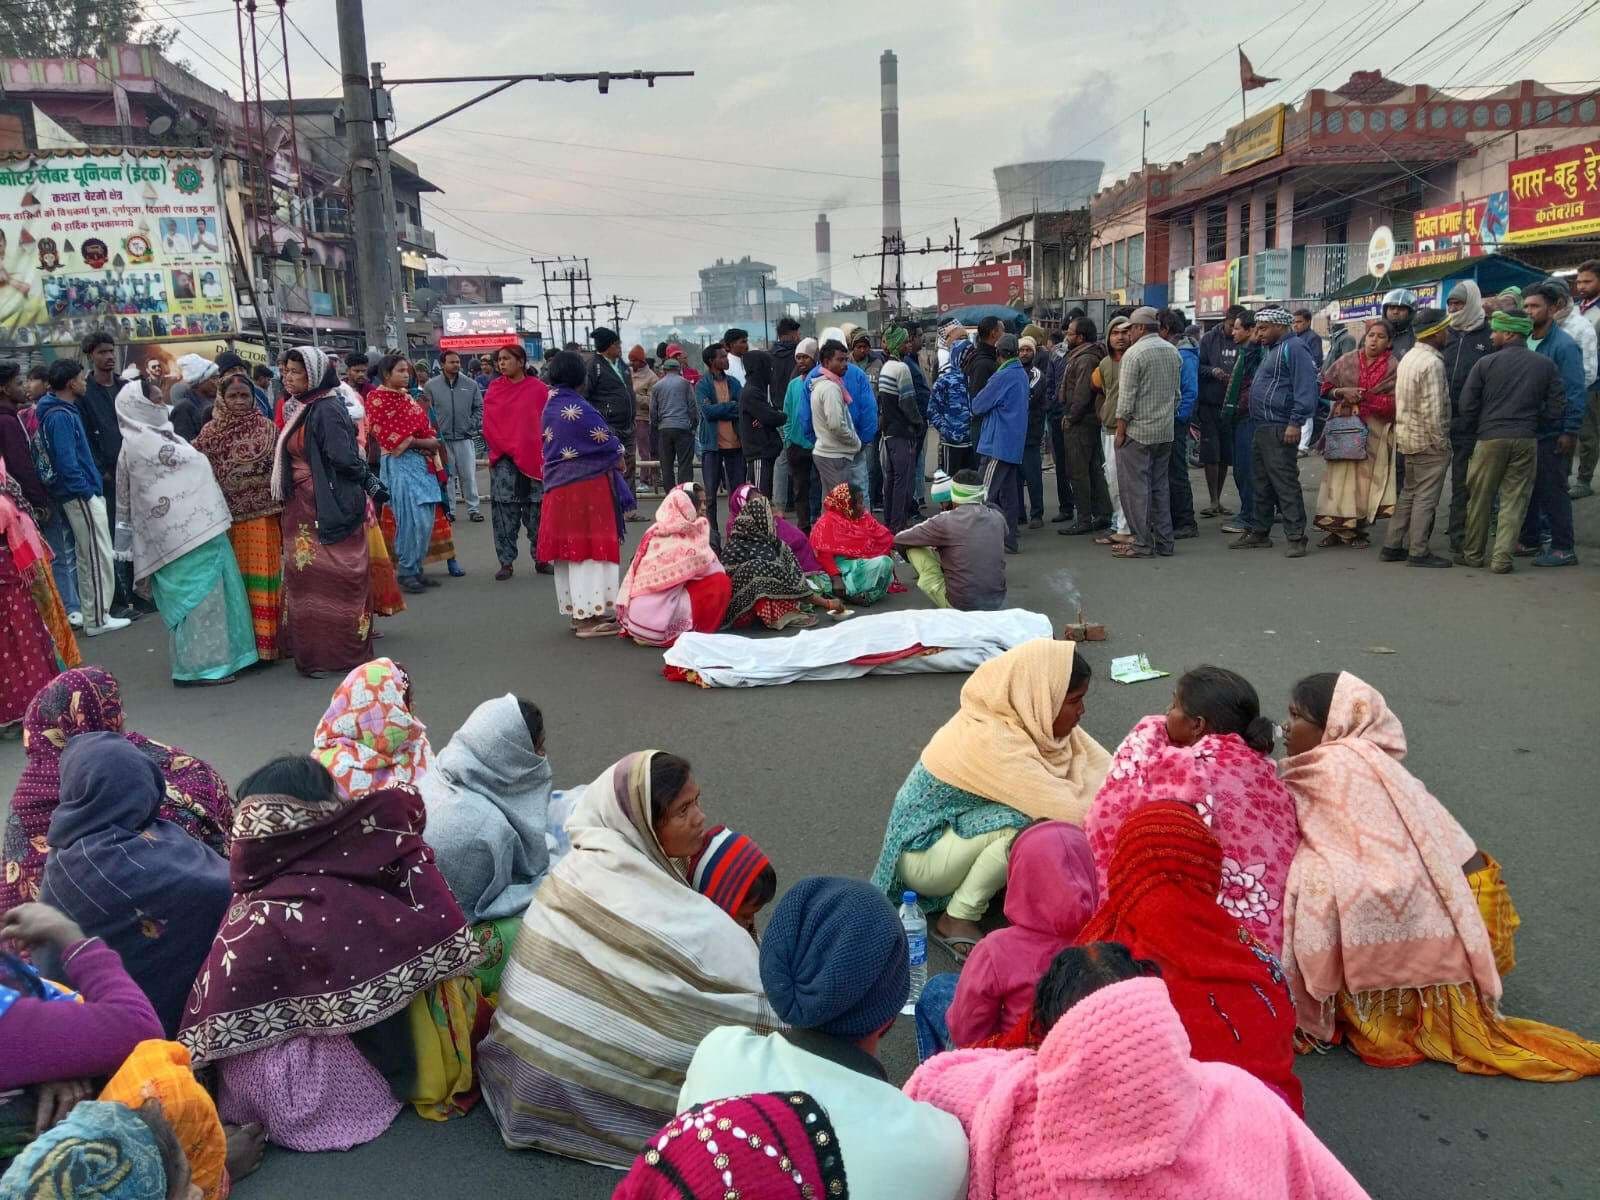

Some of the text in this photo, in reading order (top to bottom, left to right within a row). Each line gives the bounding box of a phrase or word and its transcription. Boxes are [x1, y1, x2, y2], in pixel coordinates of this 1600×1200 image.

[36, 165, 70, 183] लेबर
[71, 163, 122, 186] यूनियन
[1584, 147, 1600, 191] ड्रे
[109, 189, 123, 201] क्षेत्र
[216, 345, 267, 361] DIECTOR
